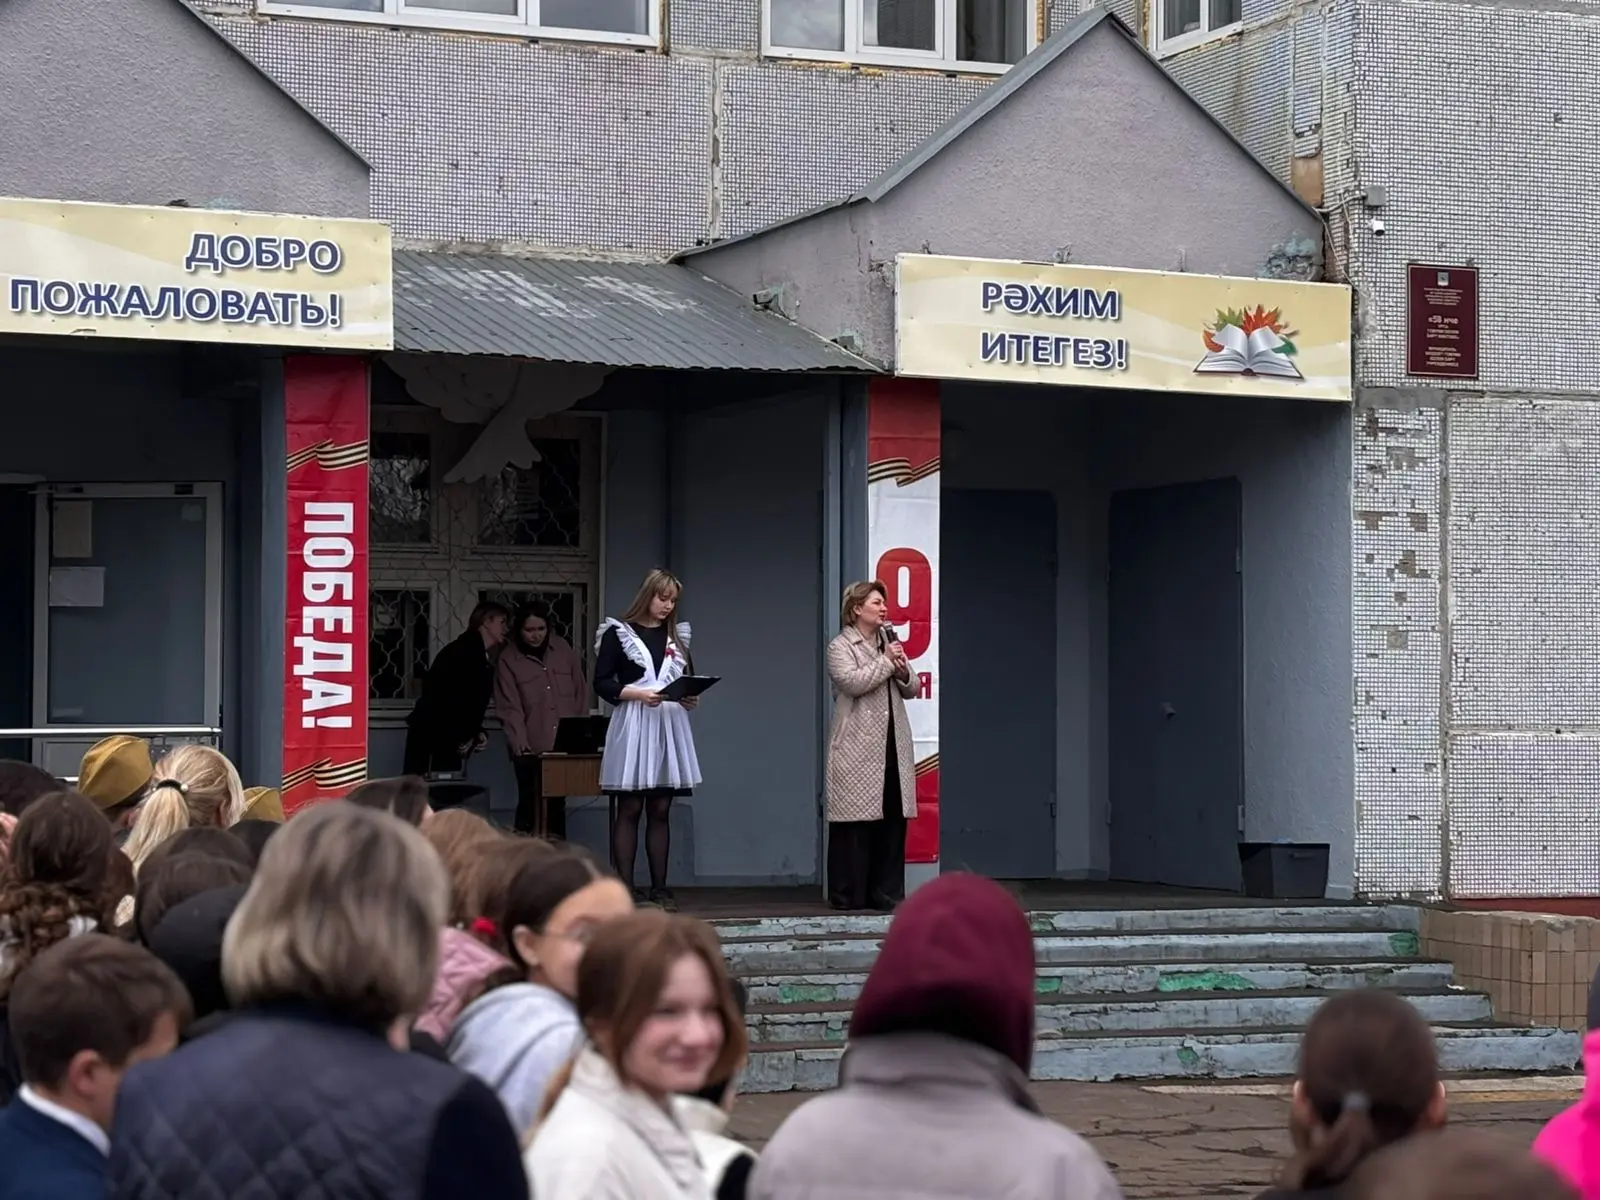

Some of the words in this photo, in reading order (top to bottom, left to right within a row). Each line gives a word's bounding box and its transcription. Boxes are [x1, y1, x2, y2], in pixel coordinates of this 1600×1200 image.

[185, 233, 341, 272] ДОБРО
[9, 278, 340, 327] ПОЖАЛОВАТЬ!
[981, 281, 1119, 319] РӘХИМ
[981, 332, 1127, 368] ИТЕГЕЗ!
[293, 501, 355, 729] ПОБЕДА!
[876, 547, 932, 662] 9
